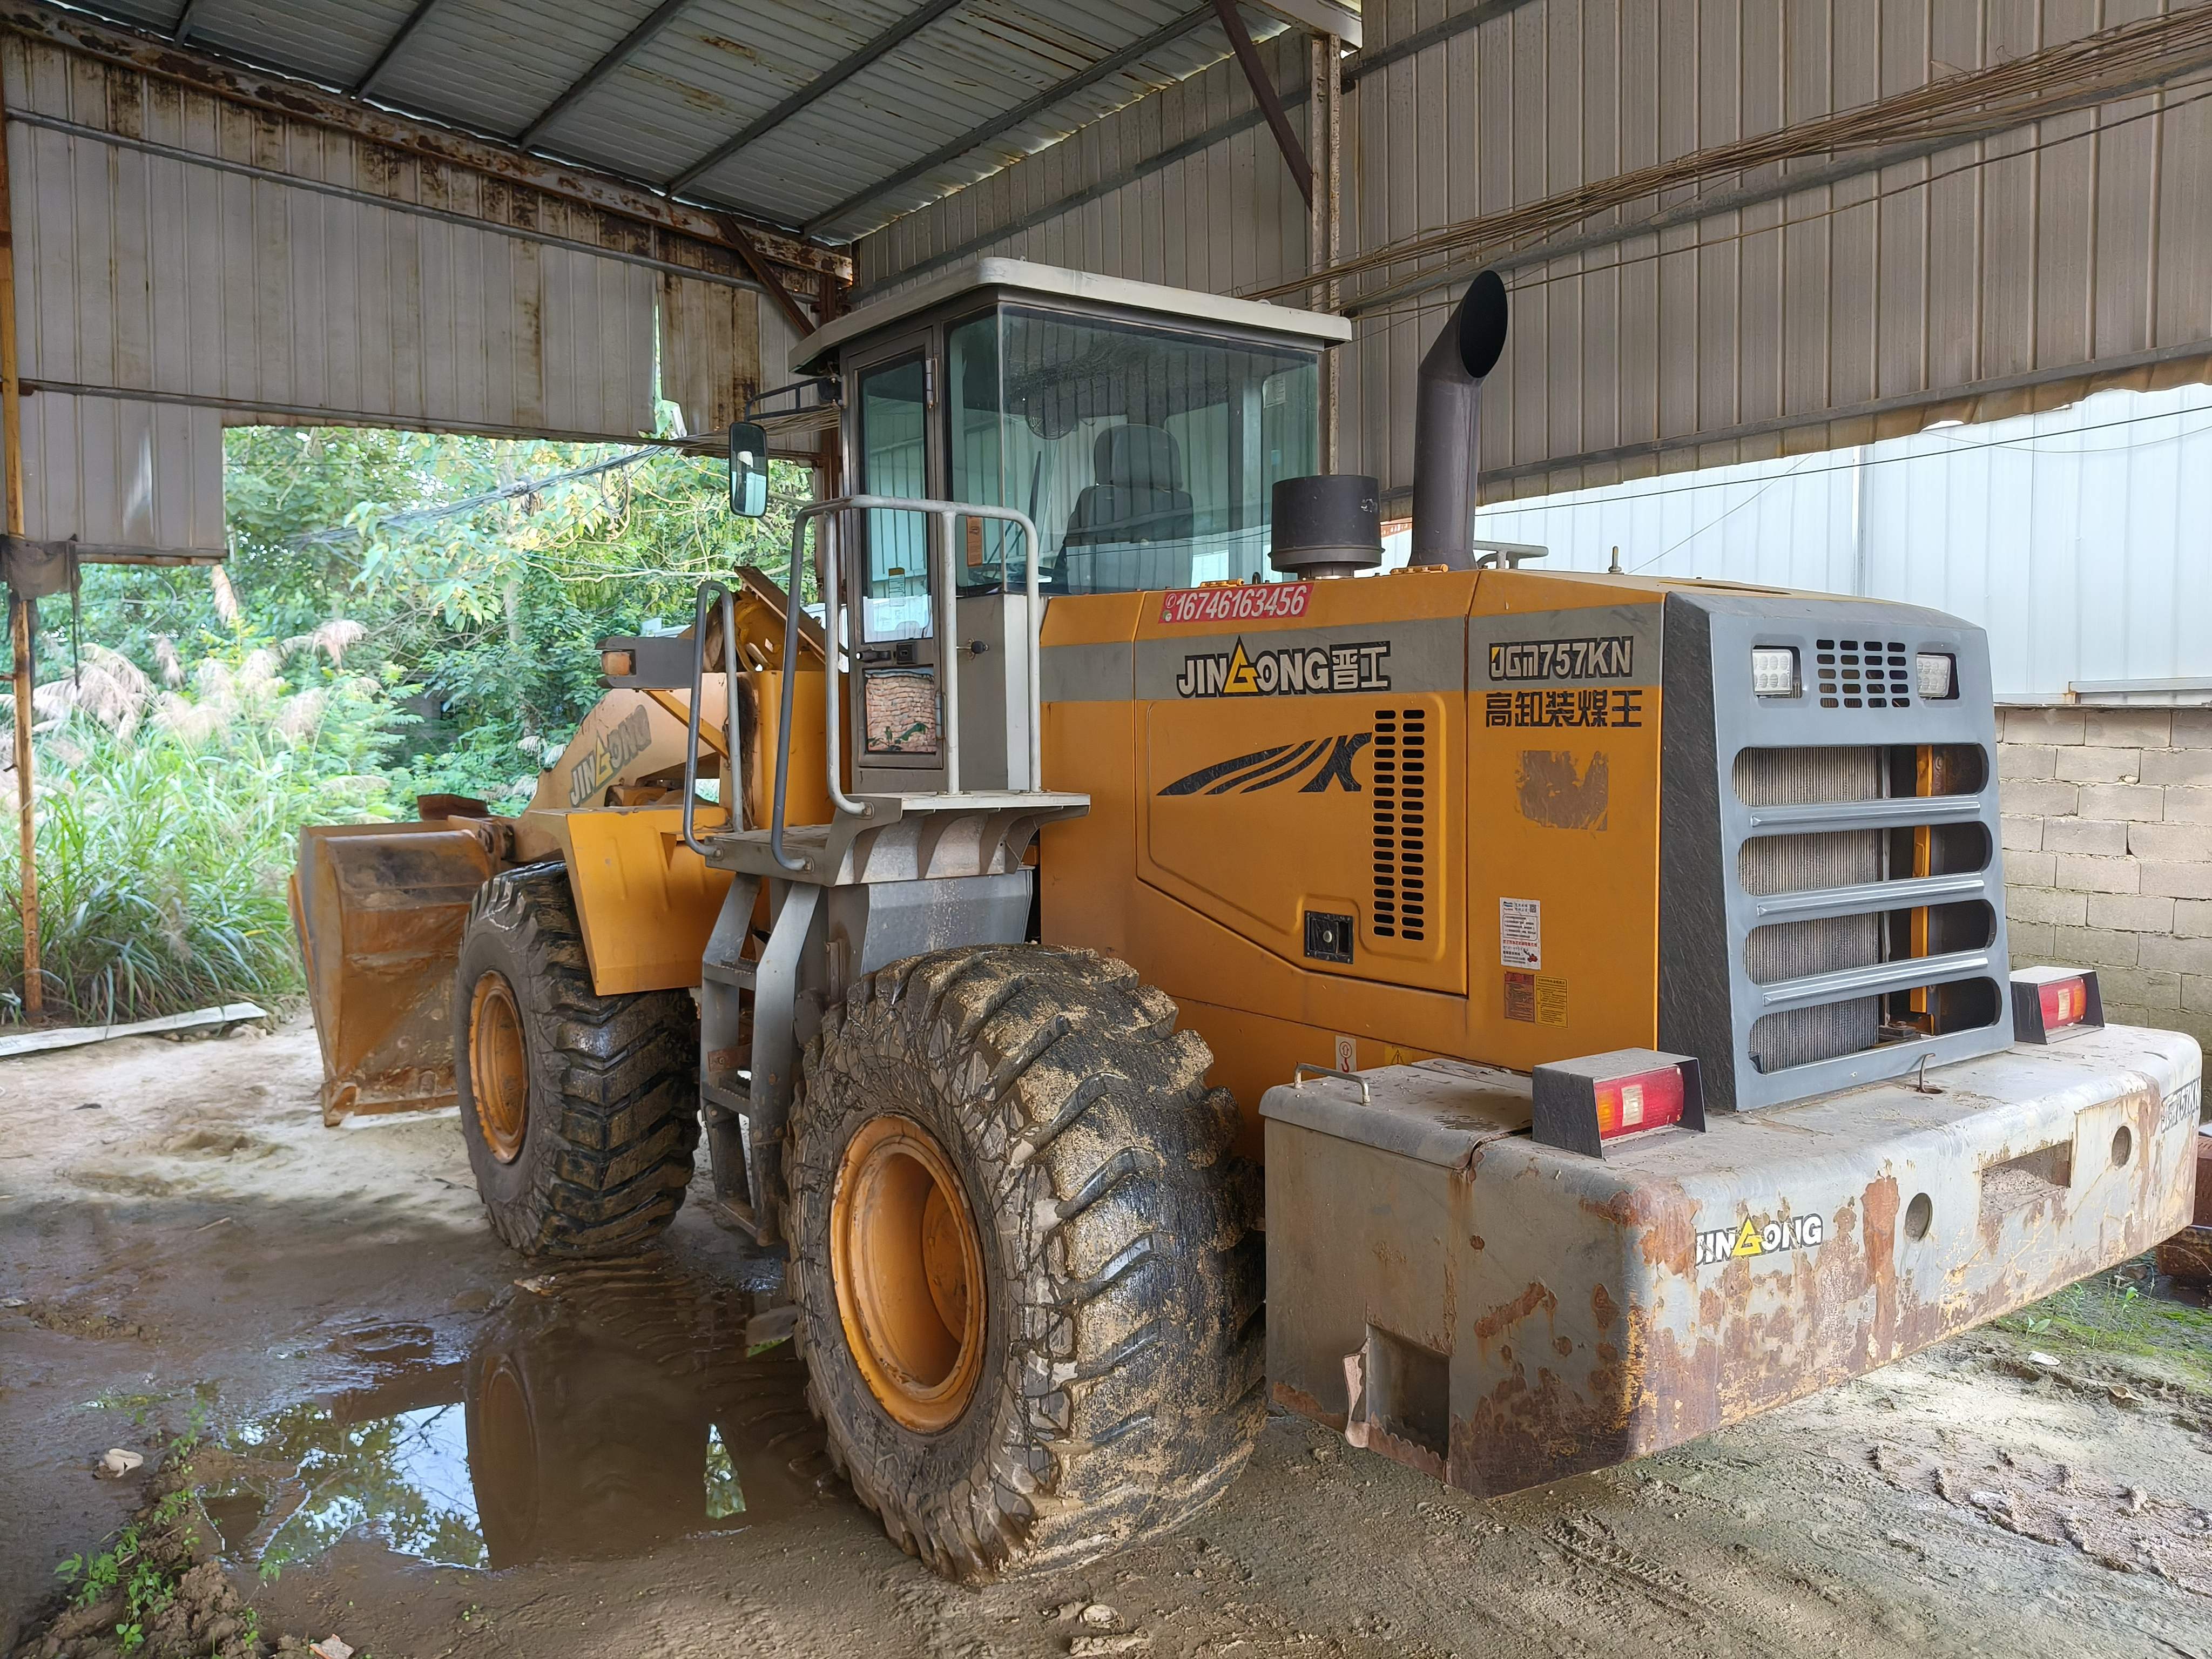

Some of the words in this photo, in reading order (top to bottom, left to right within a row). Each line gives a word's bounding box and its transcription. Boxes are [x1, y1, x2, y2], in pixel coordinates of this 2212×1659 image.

[1176, 586, 1307, 620] 16746163456
[1486, 689, 1643, 727] 高卸装煤王
